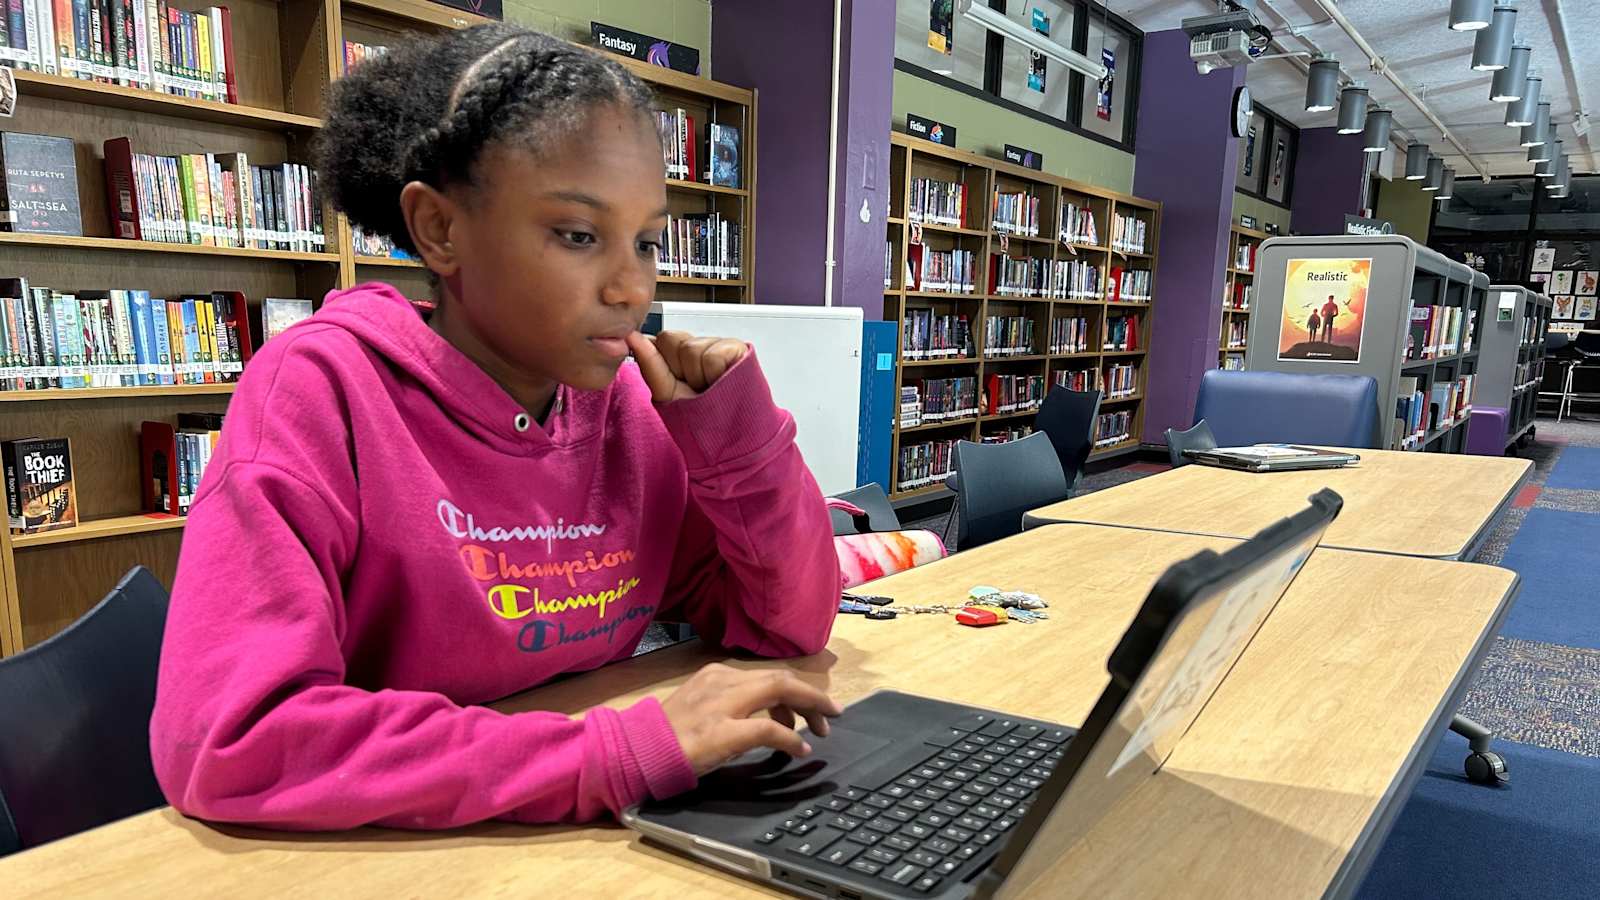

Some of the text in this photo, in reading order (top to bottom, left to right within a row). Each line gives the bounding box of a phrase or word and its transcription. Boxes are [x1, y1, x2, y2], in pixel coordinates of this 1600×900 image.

[599, 32, 637, 55] Fantasy
[909, 120, 926, 133] Fiction
[1006, 149, 1022, 163] Fantasy
[8, 168, 65, 179] RUTA SEPETYS
[11, 200, 39, 210] SALT
[46, 201, 68, 212] SEA
[1307, 271, 1348, 281] Realistic
[24, 455, 65, 470] BOOK
[26, 469, 65, 483] THIEF
[437, 499, 606, 554] Champion
[459, 544, 636, 588] Champion
[488, 577, 640, 619] Champion
[517, 605, 655, 653] Champion
